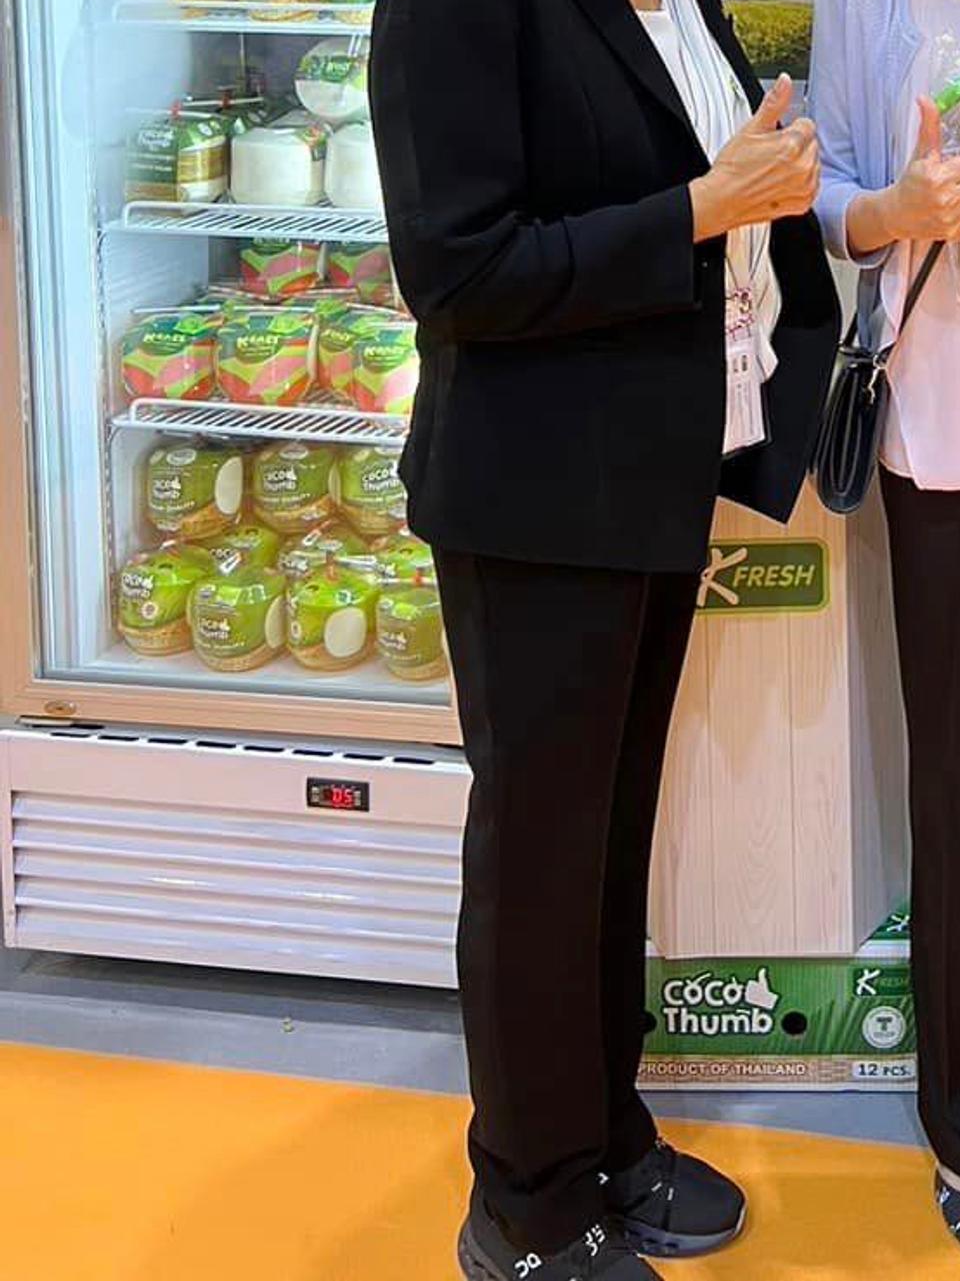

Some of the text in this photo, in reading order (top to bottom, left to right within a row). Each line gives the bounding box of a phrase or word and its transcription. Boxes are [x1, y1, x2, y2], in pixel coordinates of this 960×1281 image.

[696, 546, 816, 608] K FRESH
[662, 1007, 774, 1036] Thumb
[710, 1063, 728, 1075] OF
[736, 1062, 807, 1076] THAILAND
[858, 1063, 878, 1077] 12
